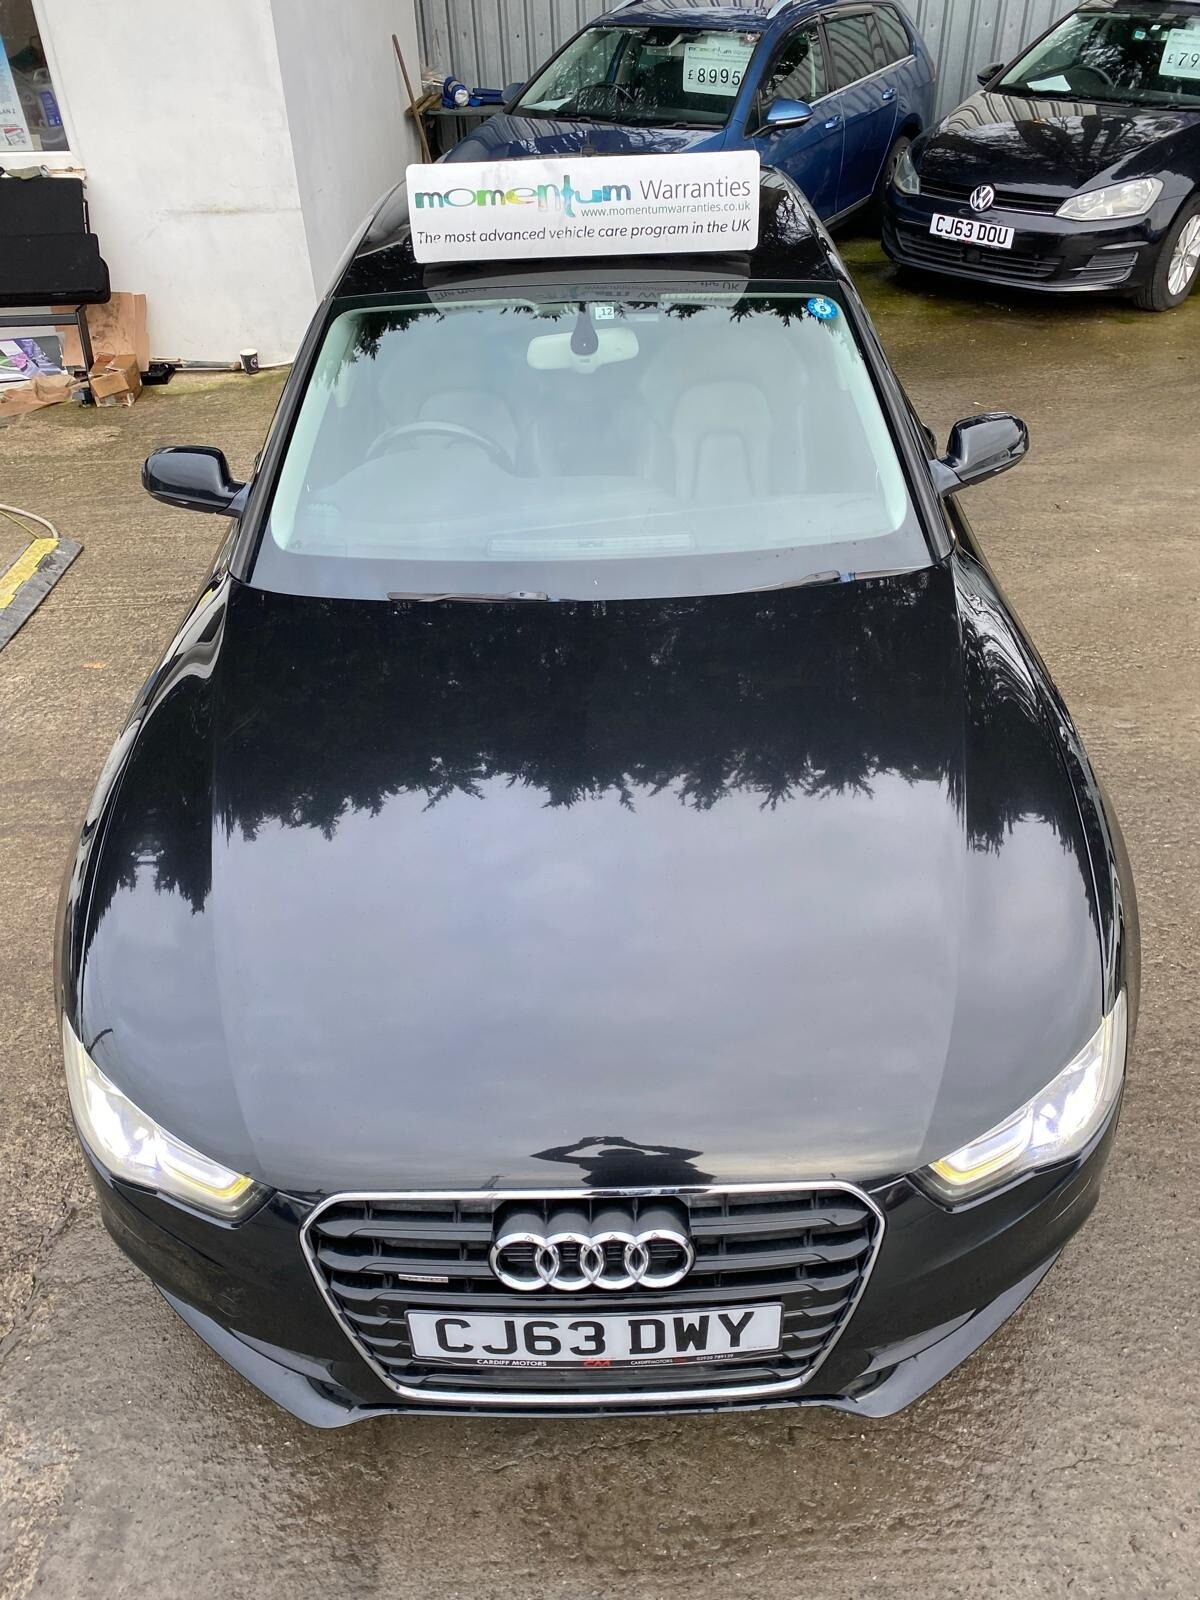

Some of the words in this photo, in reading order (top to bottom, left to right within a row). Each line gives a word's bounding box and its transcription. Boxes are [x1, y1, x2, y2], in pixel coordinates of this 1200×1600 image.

[414, 174, 632, 218] momentum
[639, 175, 751, 201] Warranties
[580, 200, 751, 217] www.momentumwarranties.co.uk
[417, 231, 441, 245] The
[445, 231, 475, 243] most
[479, 227, 546, 242] advanced
[549, 225, 595, 240] vehicle
[598, 226, 627, 238] care
[630, 222, 689, 239] program
[692, 220, 704, 234] in
[707, 219, 728, 233] the
[731, 218, 751, 232] UK
[935, 216, 974, 239] CJ63
[977, 224, 1009, 245] DOU
[601, 307, 613, 316] 12
[435, 1318, 606, 1357] CJ63
[628, 1311, 755, 1355] DWY
